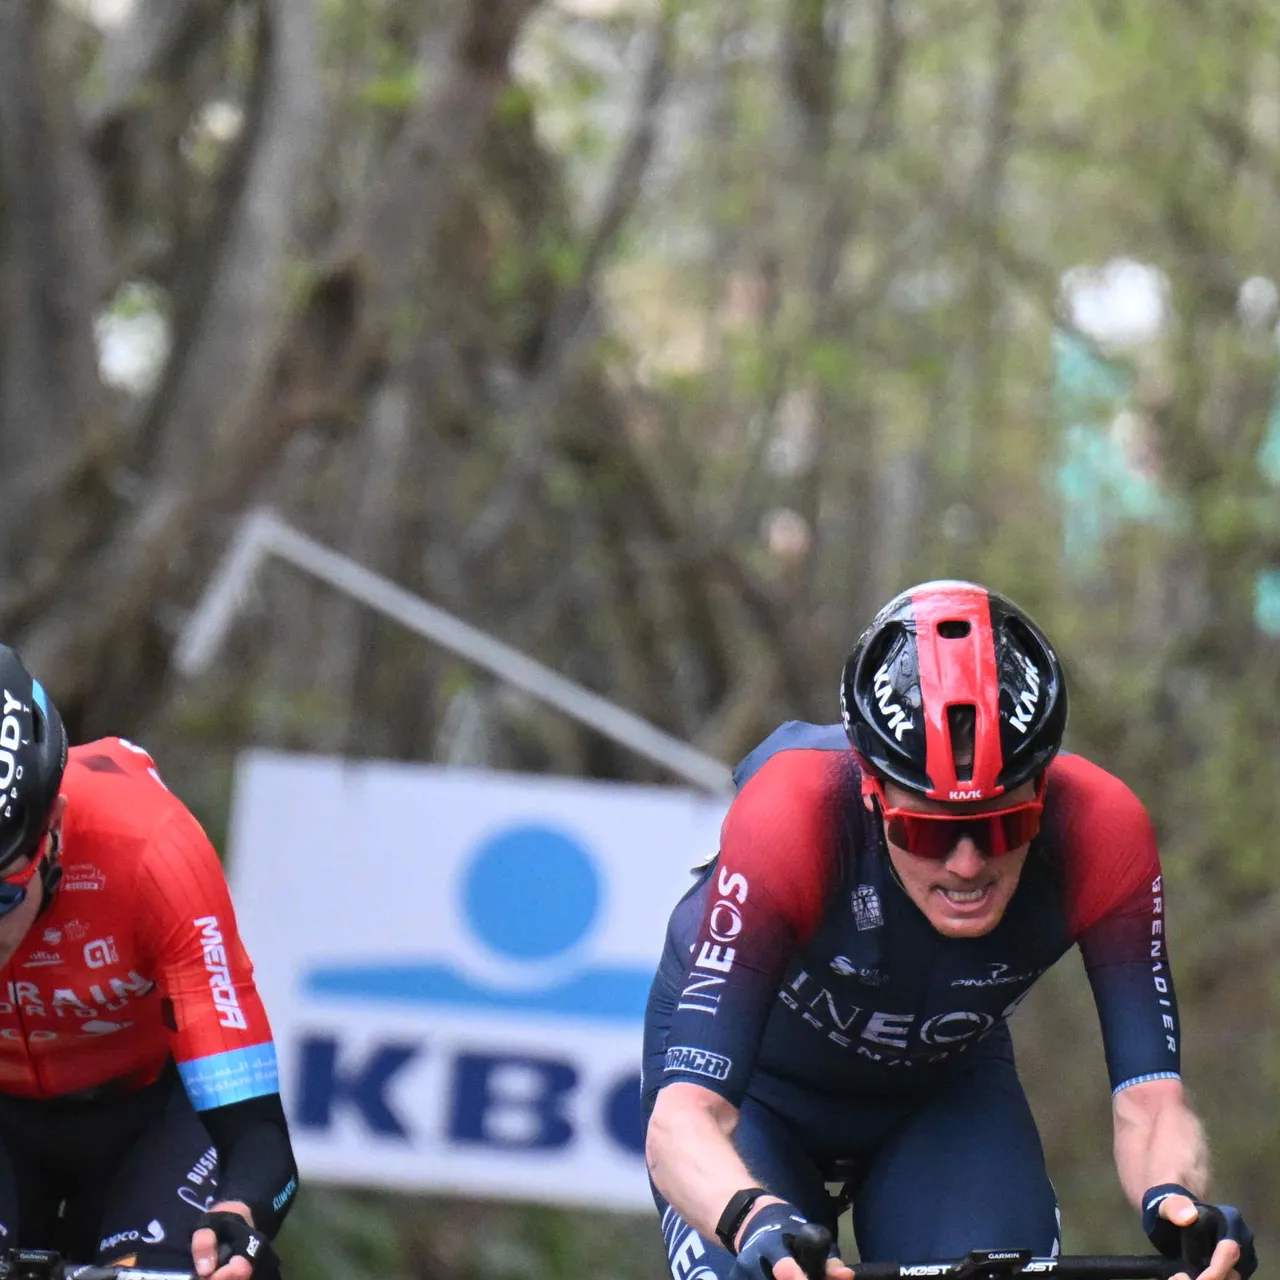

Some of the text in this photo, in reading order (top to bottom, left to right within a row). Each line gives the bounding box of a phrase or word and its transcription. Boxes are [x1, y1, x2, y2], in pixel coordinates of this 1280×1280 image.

[873, 664, 914, 742] KASK
[1009, 656, 1041, 733] KASK
[949, 791, 982, 800] KASK
[193, 916, 248, 1029] MERDA
[677, 865, 749, 1016] INEOS
[1151, 875, 1176, 1053] GRENADIER
[779, 968, 998, 1050] INEO
[664, 1048, 729, 1079] ORACER
